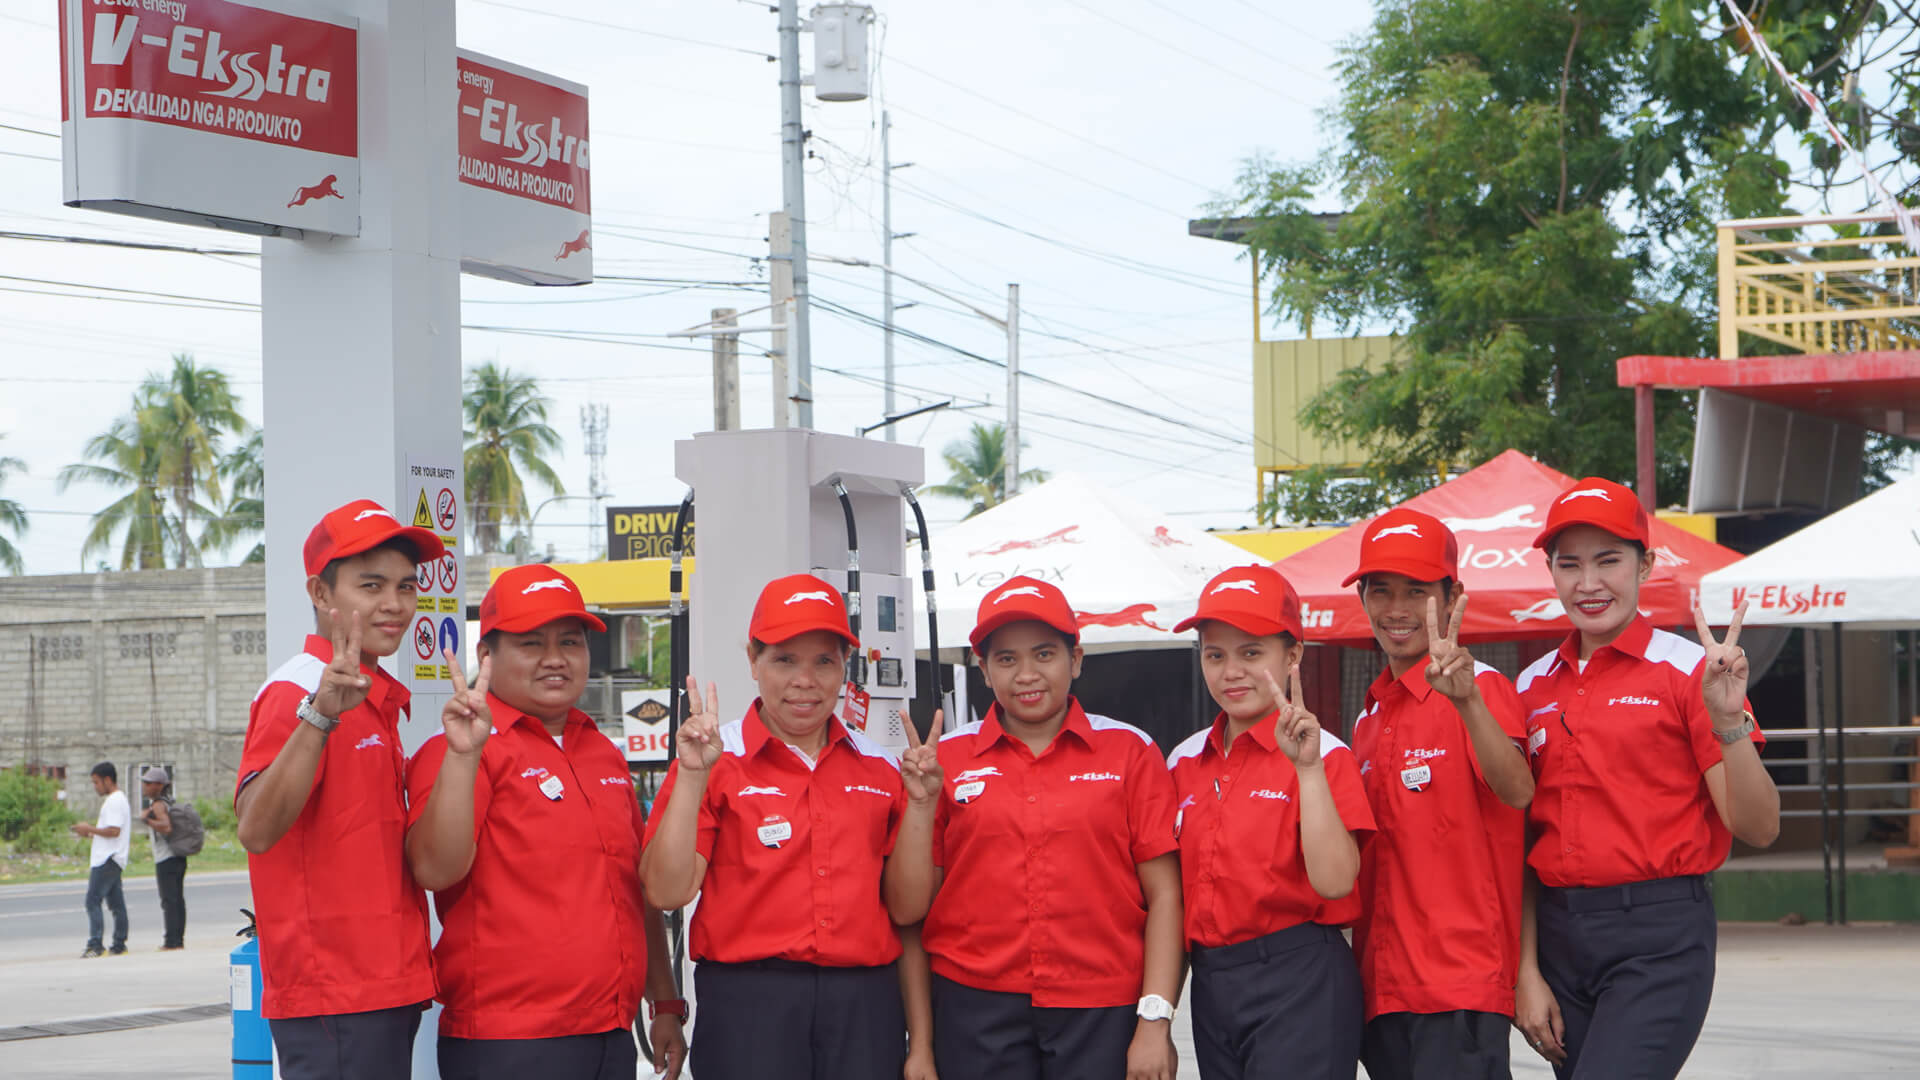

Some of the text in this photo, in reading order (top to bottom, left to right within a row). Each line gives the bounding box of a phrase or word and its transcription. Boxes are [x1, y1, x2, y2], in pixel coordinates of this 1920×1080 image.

[143, 0, 187, 23] energy
[463, 70, 494, 95] energy
[94, 87, 301, 142] DEKALIDAD NGA PRODUKTO
[497, 165, 519, 190] NGA
[521, 171, 575, 204] PRODUKTO
[411, 465, 455, 480] FOR YOUR SAFETY
[954, 564, 1072, 588] velox
